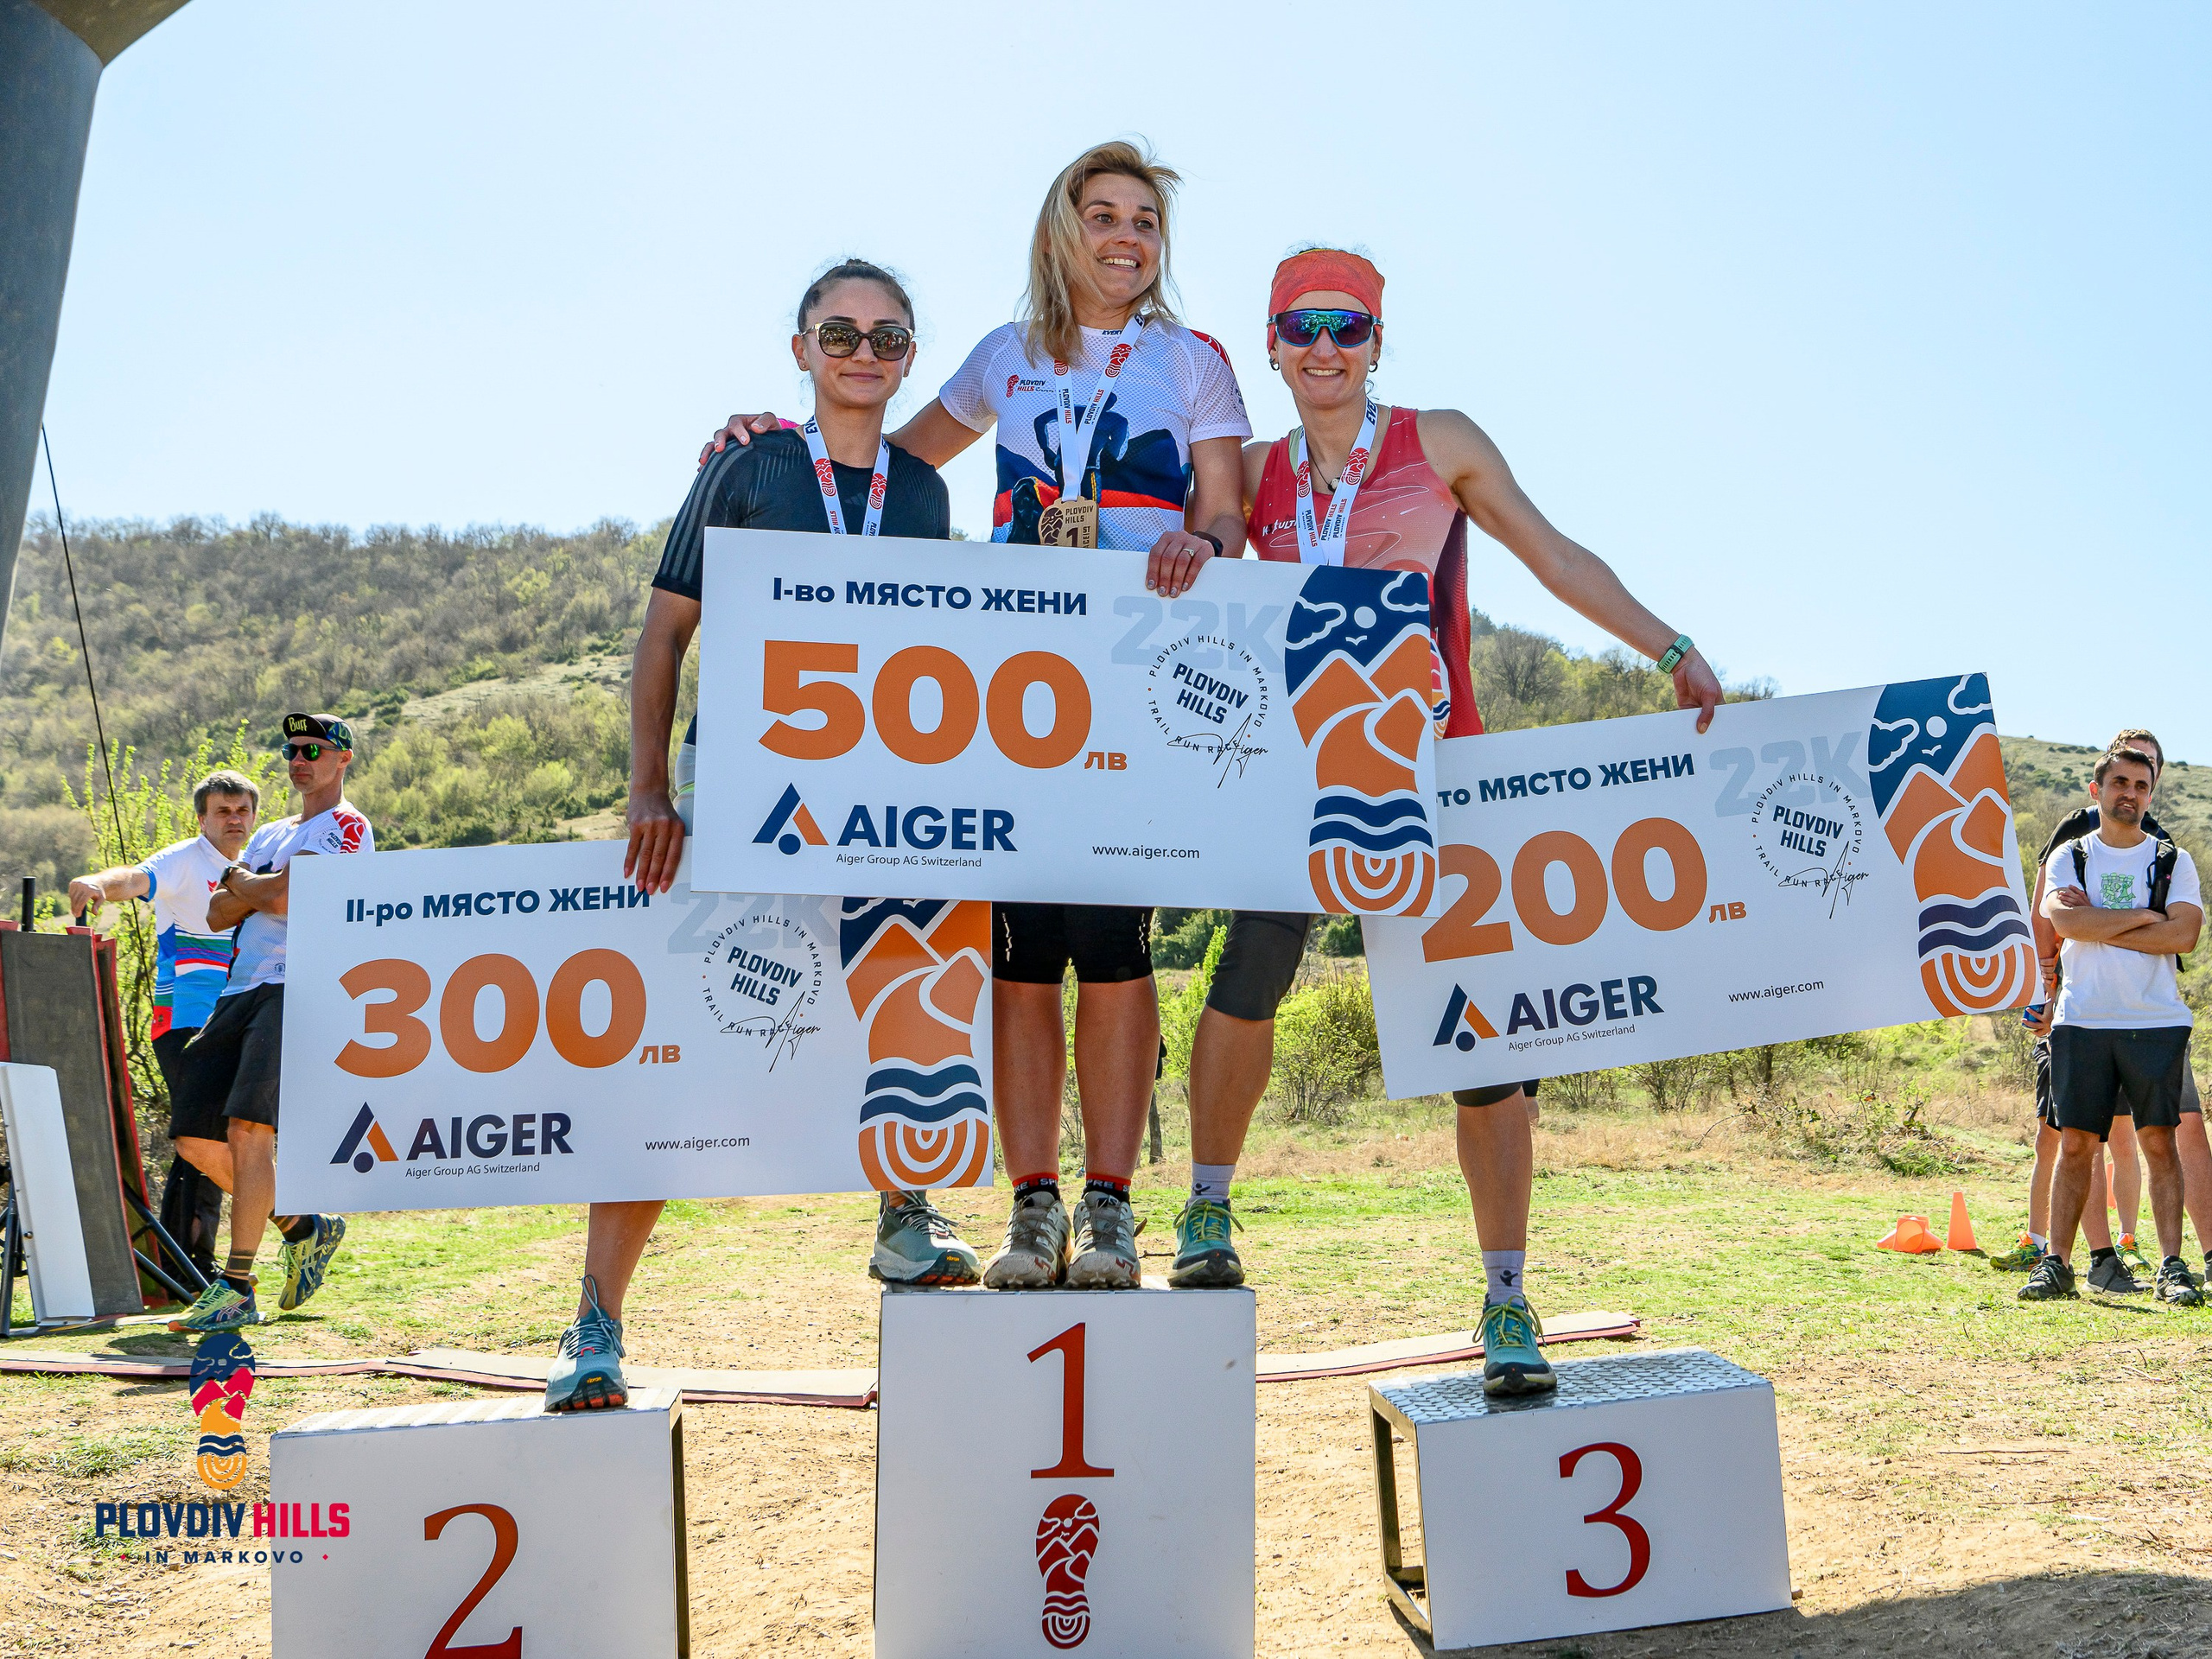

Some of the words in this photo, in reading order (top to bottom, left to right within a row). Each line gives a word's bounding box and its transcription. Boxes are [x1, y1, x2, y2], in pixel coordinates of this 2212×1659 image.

[1065, 505, 1094, 516] PLOVDIV
[1065, 515, 1084, 524] HILLS
[846, 581, 972, 610] МЯСТО
[980, 588, 1087, 615] ЖЕНИ
[1149, 637, 1190, 677] PLOVDIV
[1198, 635, 1236, 651] HILLS
[1239, 650, 1252, 663] IN
[1253, 666, 1268, 728] MARKOVO
[1173, 663, 1249, 709] PLOVDIV
[759, 640, 1091, 769] 500
[1148, 700, 1169, 734] TRAIL
[1175, 735, 1199, 751] RUN
[1176, 688, 1228, 724] HILLS
[1478, 766, 1592, 803] МЯСТО
[1598, 753, 1695, 788] ЖЕНИ
[837, 804, 1018, 851] AIGER
[1751, 779, 1783, 823] PLOVDIV
[1789, 773, 1824, 784] HILLS
[1829, 781, 1841, 793] IN
[1843, 795, 1862, 853] MARKOVO
[1773, 804, 1844, 839] PLOVDIV
[836, 854, 864, 865] Aiger
[867, 855, 899, 867] Group
[903, 856, 918, 865] AG
[922, 856, 982, 867] Switzerland
[1092, 845, 1199, 860] www.aiger.com
[1780, 830, 1827, 857] HILLS
[1755, 845, 1778, 877] TRAIL
[1784, 875, 1808, 887] RUN
[423, 890, 540, 918] МЯСТО
[548, 885, 651, 912] ЖЕНИ
[1421, 817, 1707, 963] 200
[704, 918, 746, 963] PLOVDIV
[753, 914, 790, 927] HILLS
[794, 926, 807, 938] IN
[807, 942, 822, 1005] MARKOVO
[727, 945, 803, 988] PLOVDIV
[730, 972, 781, 1006] HILLS
[1506, 975, 1665, 1035] AIGER
[1728, 979, 1824, 1003] www.aiger.com
[334, 948, 646, 1077] 300
[702, 987, 724, 1022] TRAIL
[728, 1022, 752, 1036] RUN
[1508, 1039, 1533, 1052] Aiger
[1535, 1035, 1565, 1050] Group
[1567, 1032, 1580, 1042] AG
[1581, 1024, 1636, 1040] Switzerland
[406, 1112, 574, 1160] AIGER
[645, 1135, 750, 1152] www.aiger.com
[405, 1166, 431, 1179] Aiger
[434, 1165, 464, 1178] Group
[467, 1164, 481, 1174] AG
[483, 1161, 540, 1173] Switzerland
[1027, 1322, 1115, 1478] 1
[1558, 1441, 1651, 1598] 3
[423, 1503, 523, 1659] 2
